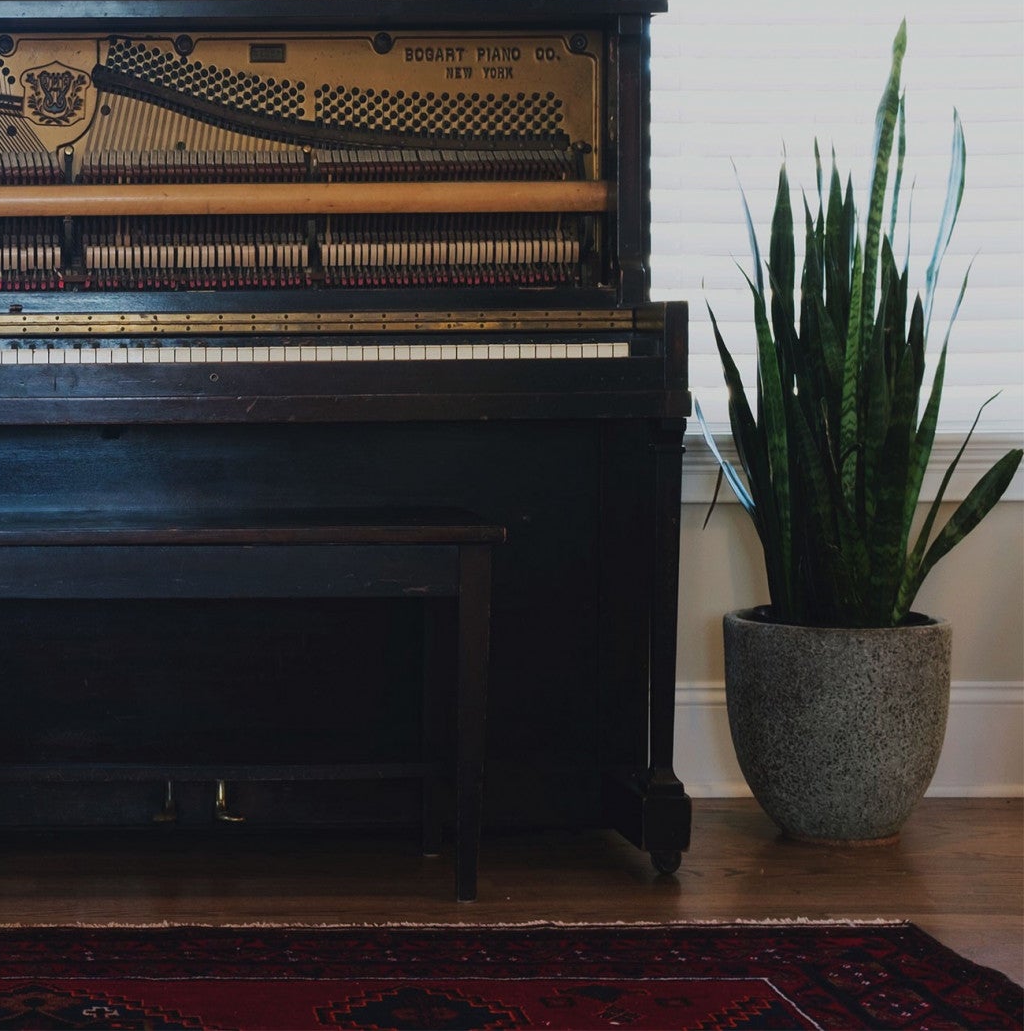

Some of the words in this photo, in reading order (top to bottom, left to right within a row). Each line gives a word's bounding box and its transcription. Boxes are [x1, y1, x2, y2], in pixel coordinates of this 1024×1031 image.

[405, 47, 465, 62] BOGART
[477, 47, 521, 62] PIANO
[446, 67, 472, 79] NEW
[482, 66, 513, 79] YORK
